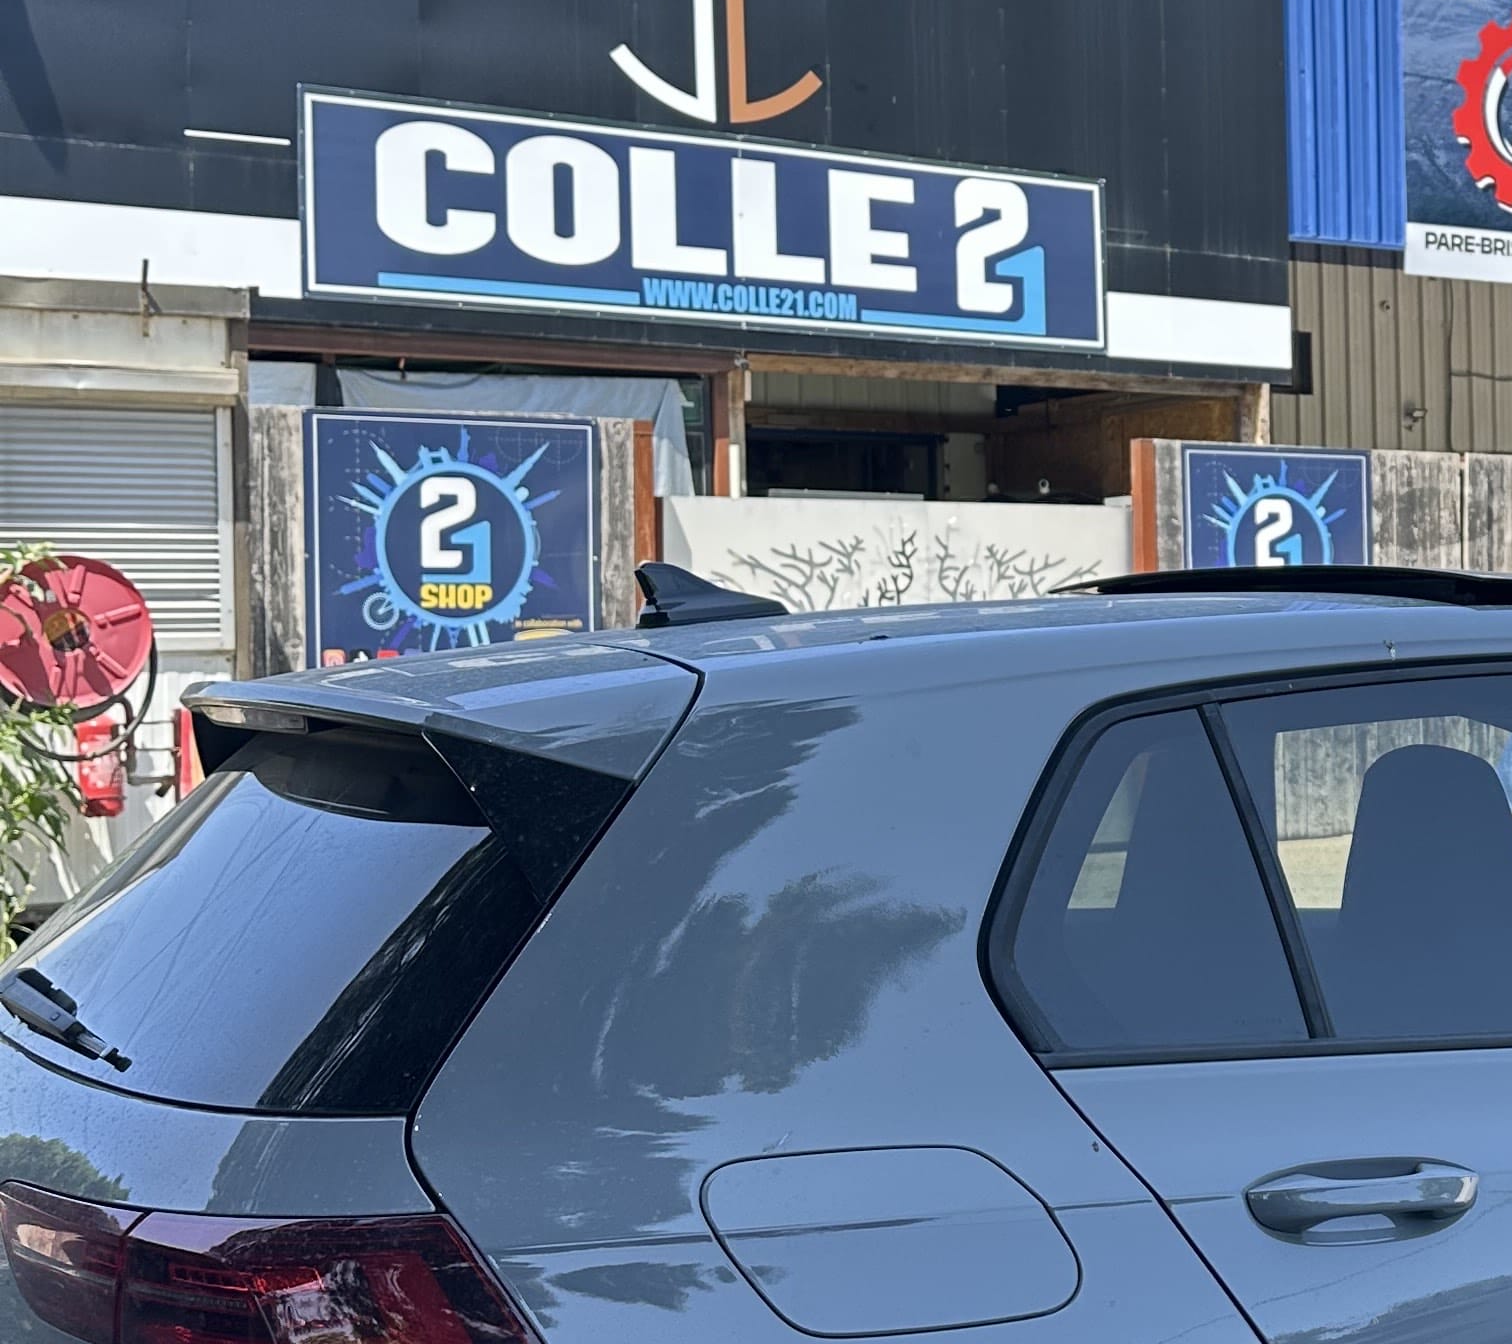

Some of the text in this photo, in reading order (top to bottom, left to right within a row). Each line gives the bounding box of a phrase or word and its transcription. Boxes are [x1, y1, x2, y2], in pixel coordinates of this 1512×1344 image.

[375, 121, 918, 293] COLLE
[641, 277, 858, 322] WWW.COLLE21.COM
[420, 476, 491, 584] 21
[420, 583, 493, 610] SHOP
